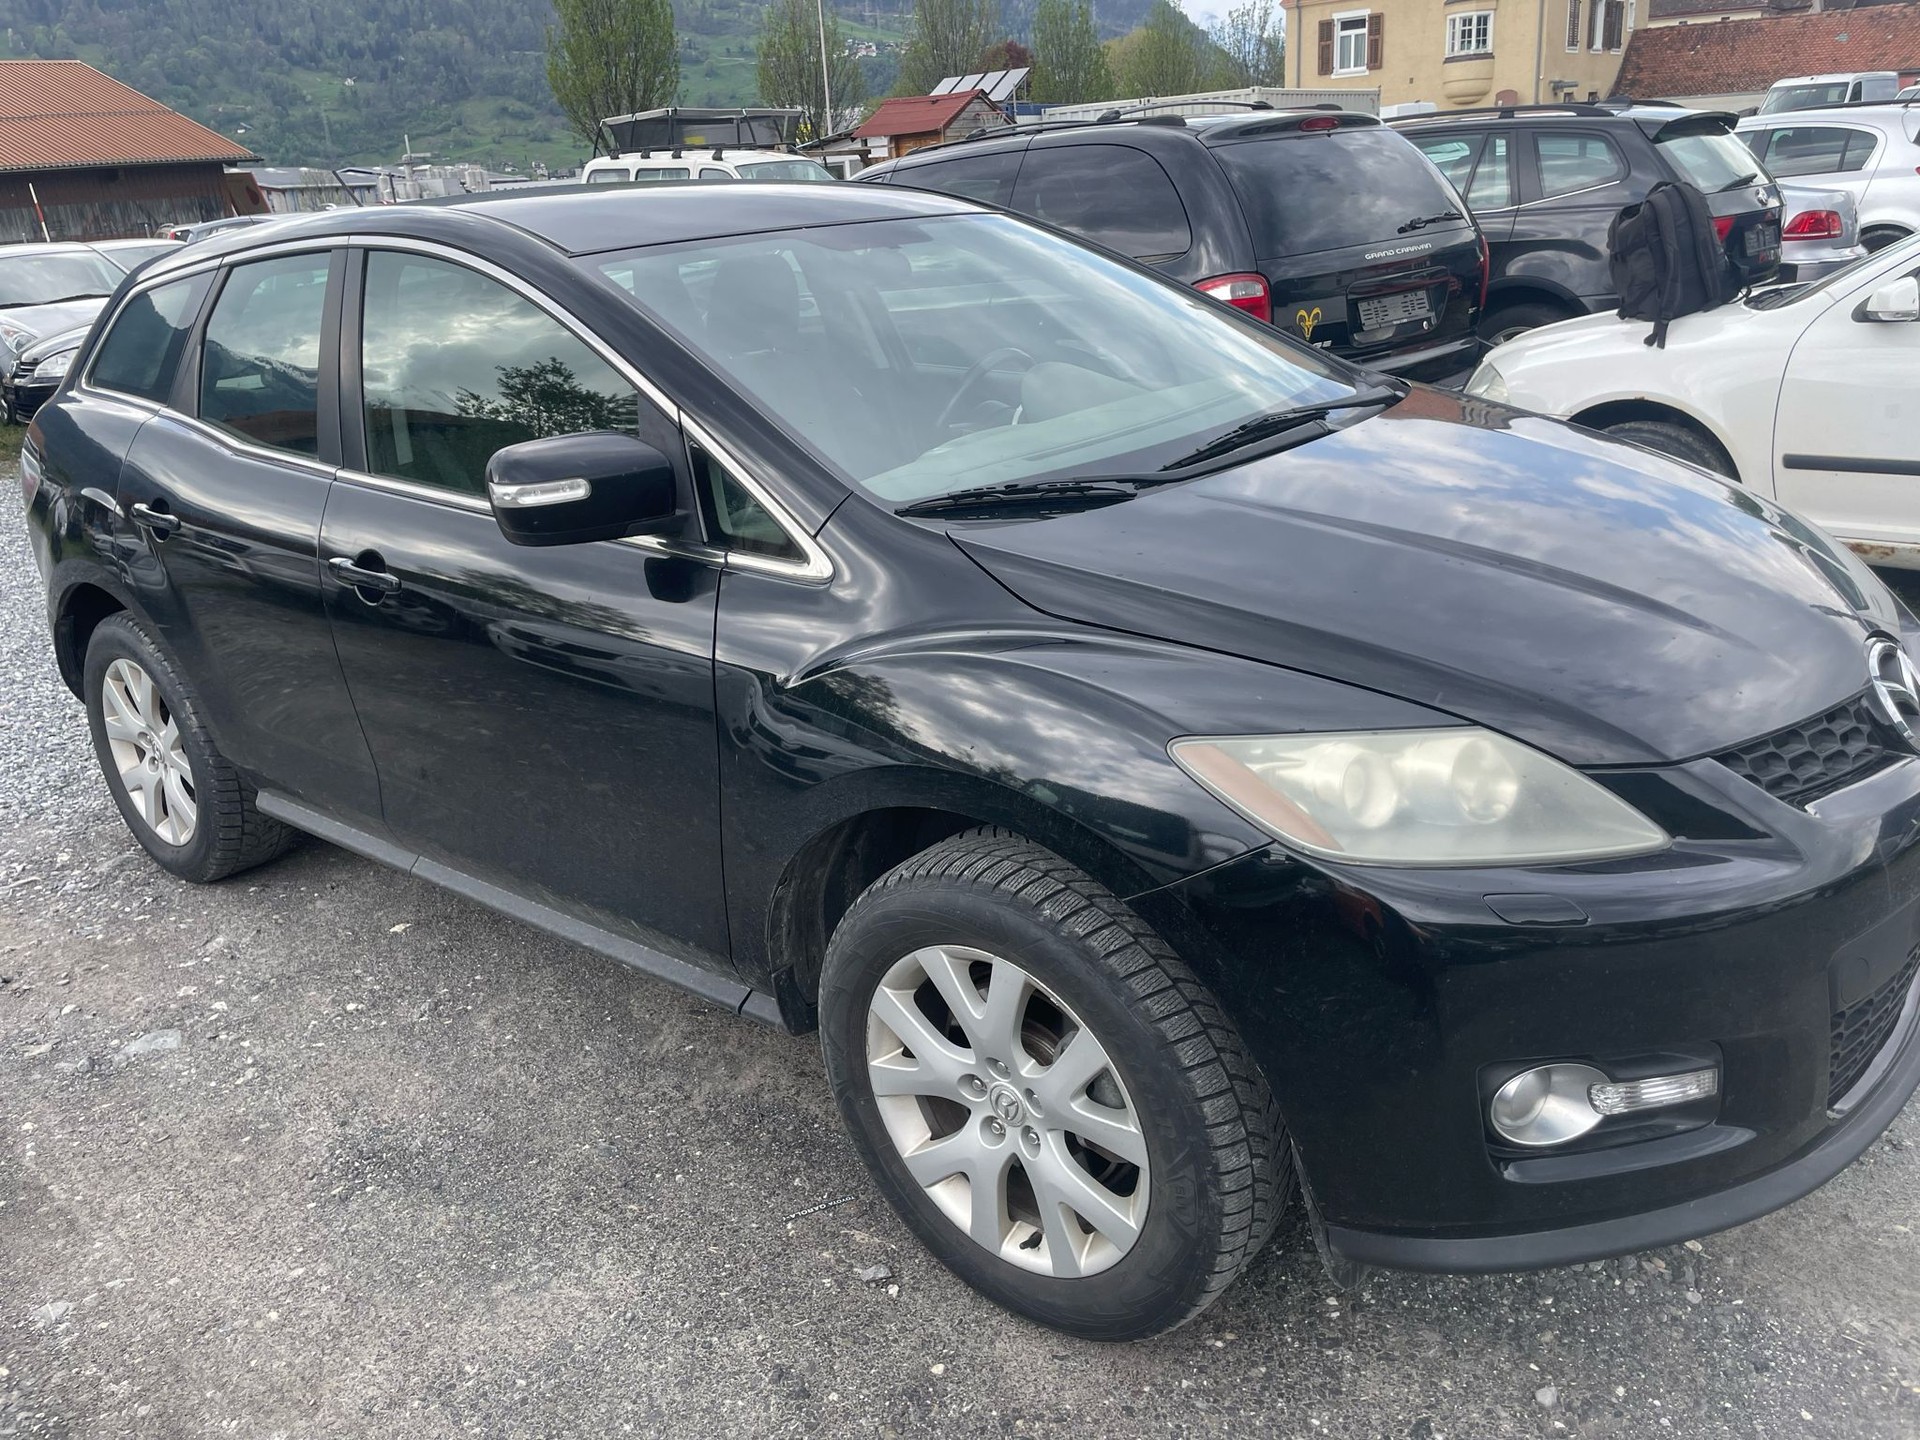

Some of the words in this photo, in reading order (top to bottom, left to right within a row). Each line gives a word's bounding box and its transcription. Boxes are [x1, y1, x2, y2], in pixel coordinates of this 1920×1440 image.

[1364, 249, 1395, 260] GRAND
[1395, 242, 1432, 255] CARAVAN
[828, 1195, 855, 1206] TOYOTA
